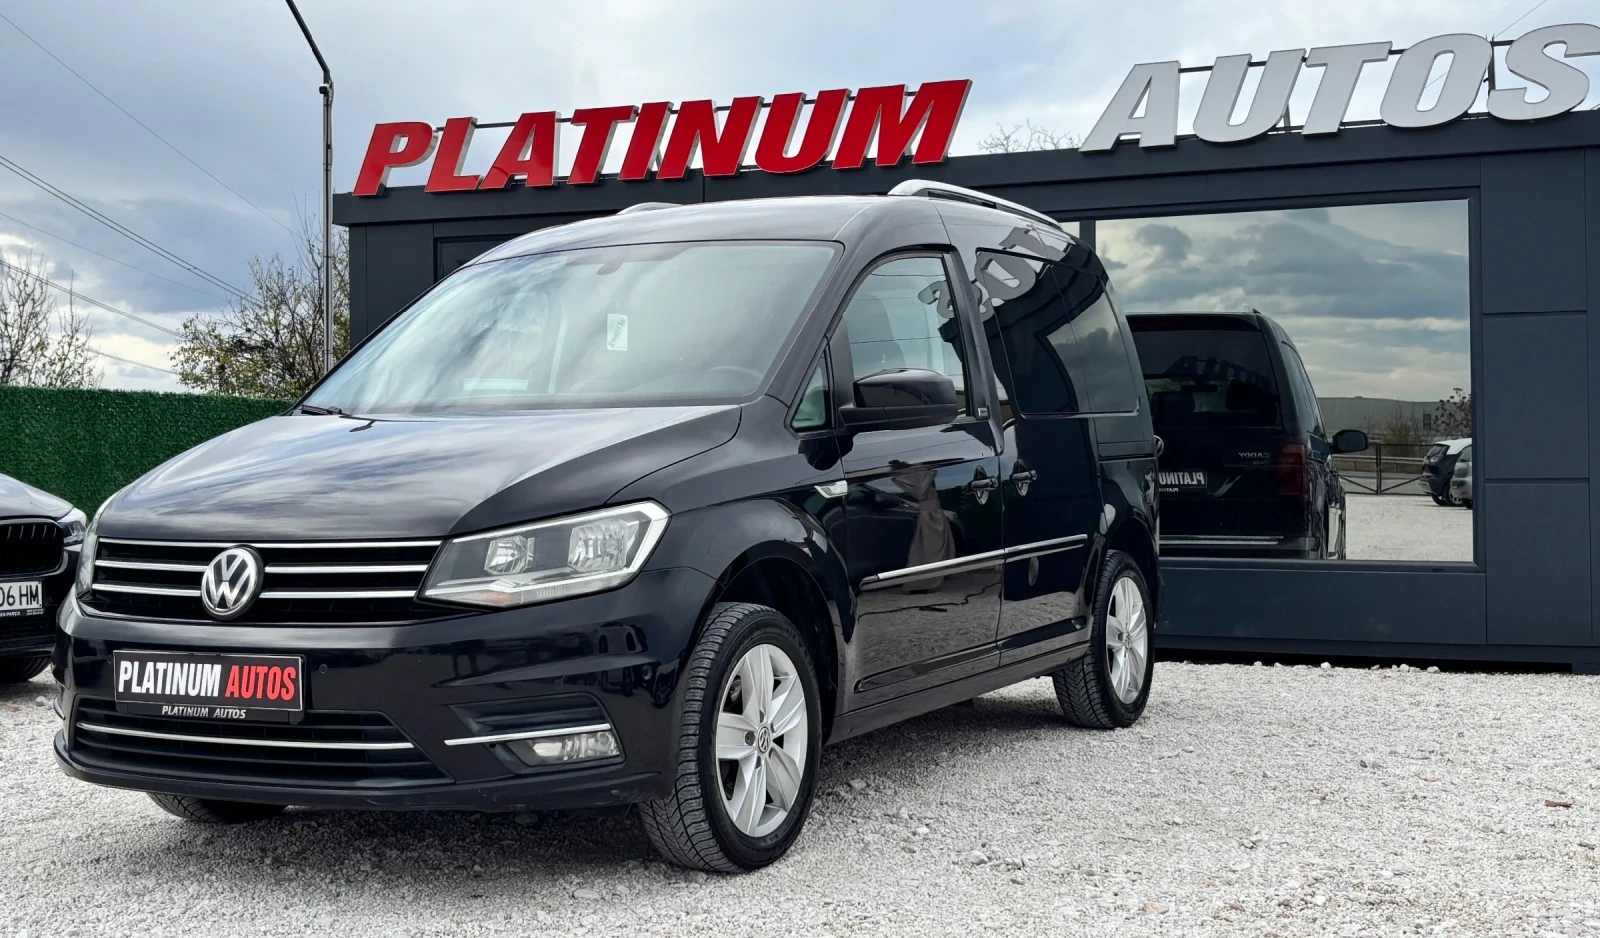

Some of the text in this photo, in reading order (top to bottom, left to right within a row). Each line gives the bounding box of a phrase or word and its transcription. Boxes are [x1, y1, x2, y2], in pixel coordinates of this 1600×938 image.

[352, 23, 1600, 197] PLATINUM AUTOS
[18, 584, 39, 606] HM
[118, 660, 297, 701] PLATINUM AUTOS
[161, 705, 247, 719] PLATINUM AUTOS
